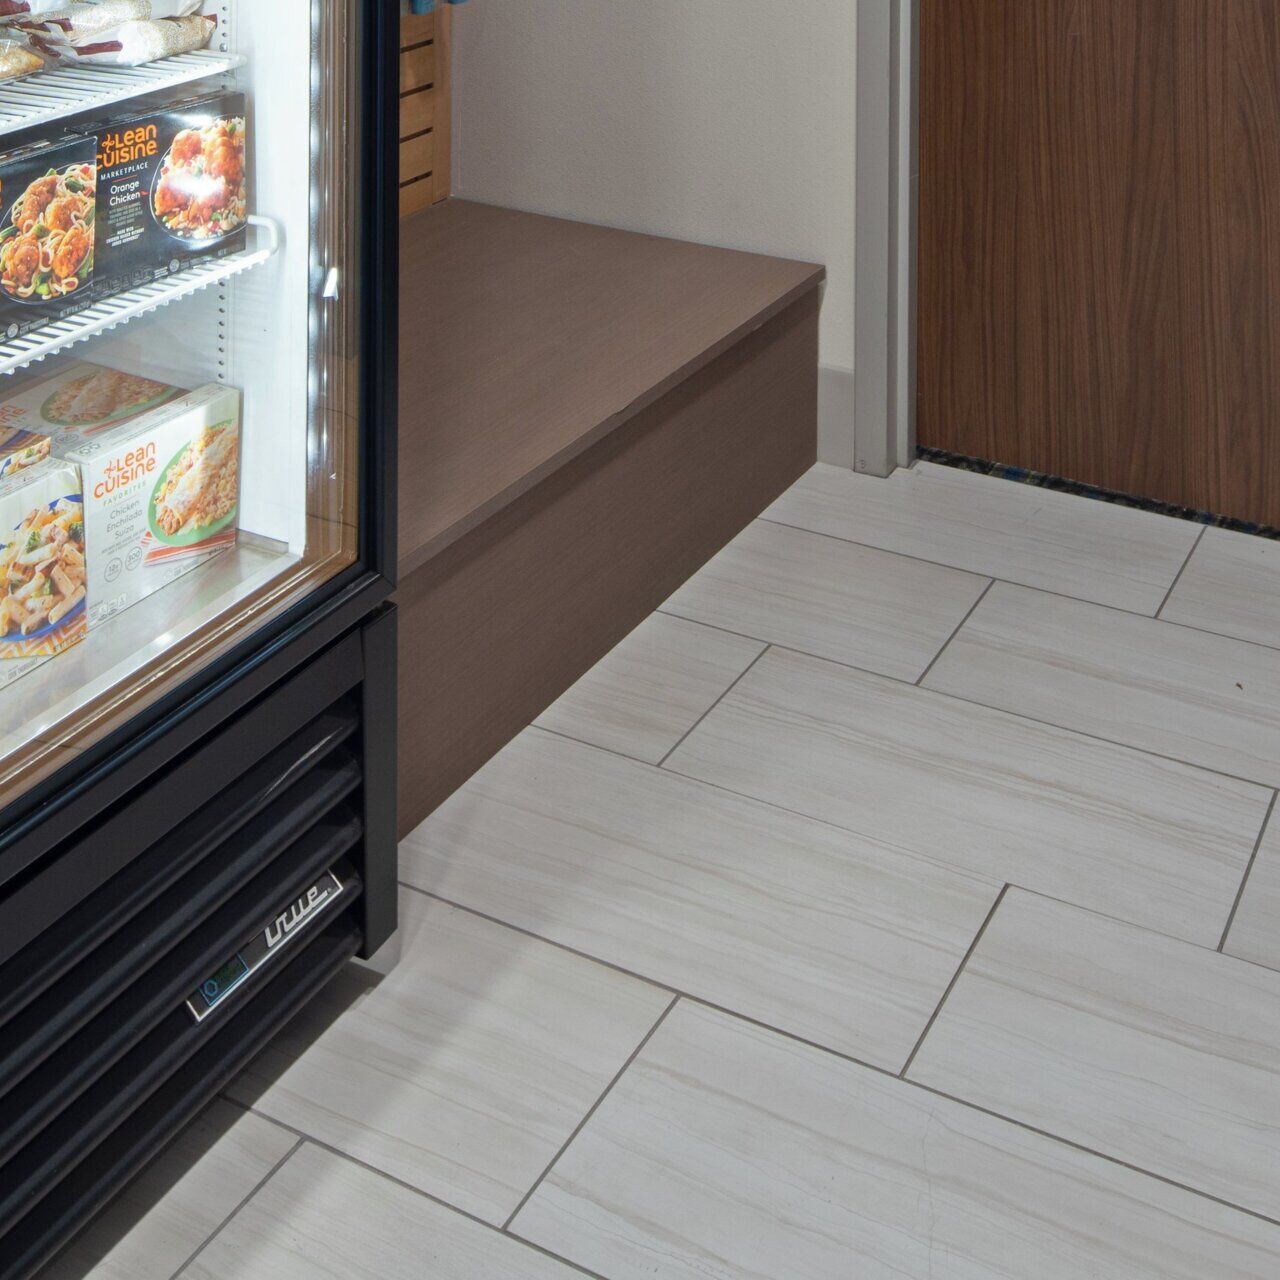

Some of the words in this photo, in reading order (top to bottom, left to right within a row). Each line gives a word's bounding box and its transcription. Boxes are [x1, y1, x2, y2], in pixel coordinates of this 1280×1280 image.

[115, 124, 157, 149] Lean
[100, 162, 149, 181] MARKETPLACE
[110, 181, 139, 195] Orange
[110, 191, 141, 206] Chicken
[117, 441, 156, 472] Lean
[103, 480, 147, 507] FAVORITES
[110, 500, 140, 520] Chicken
